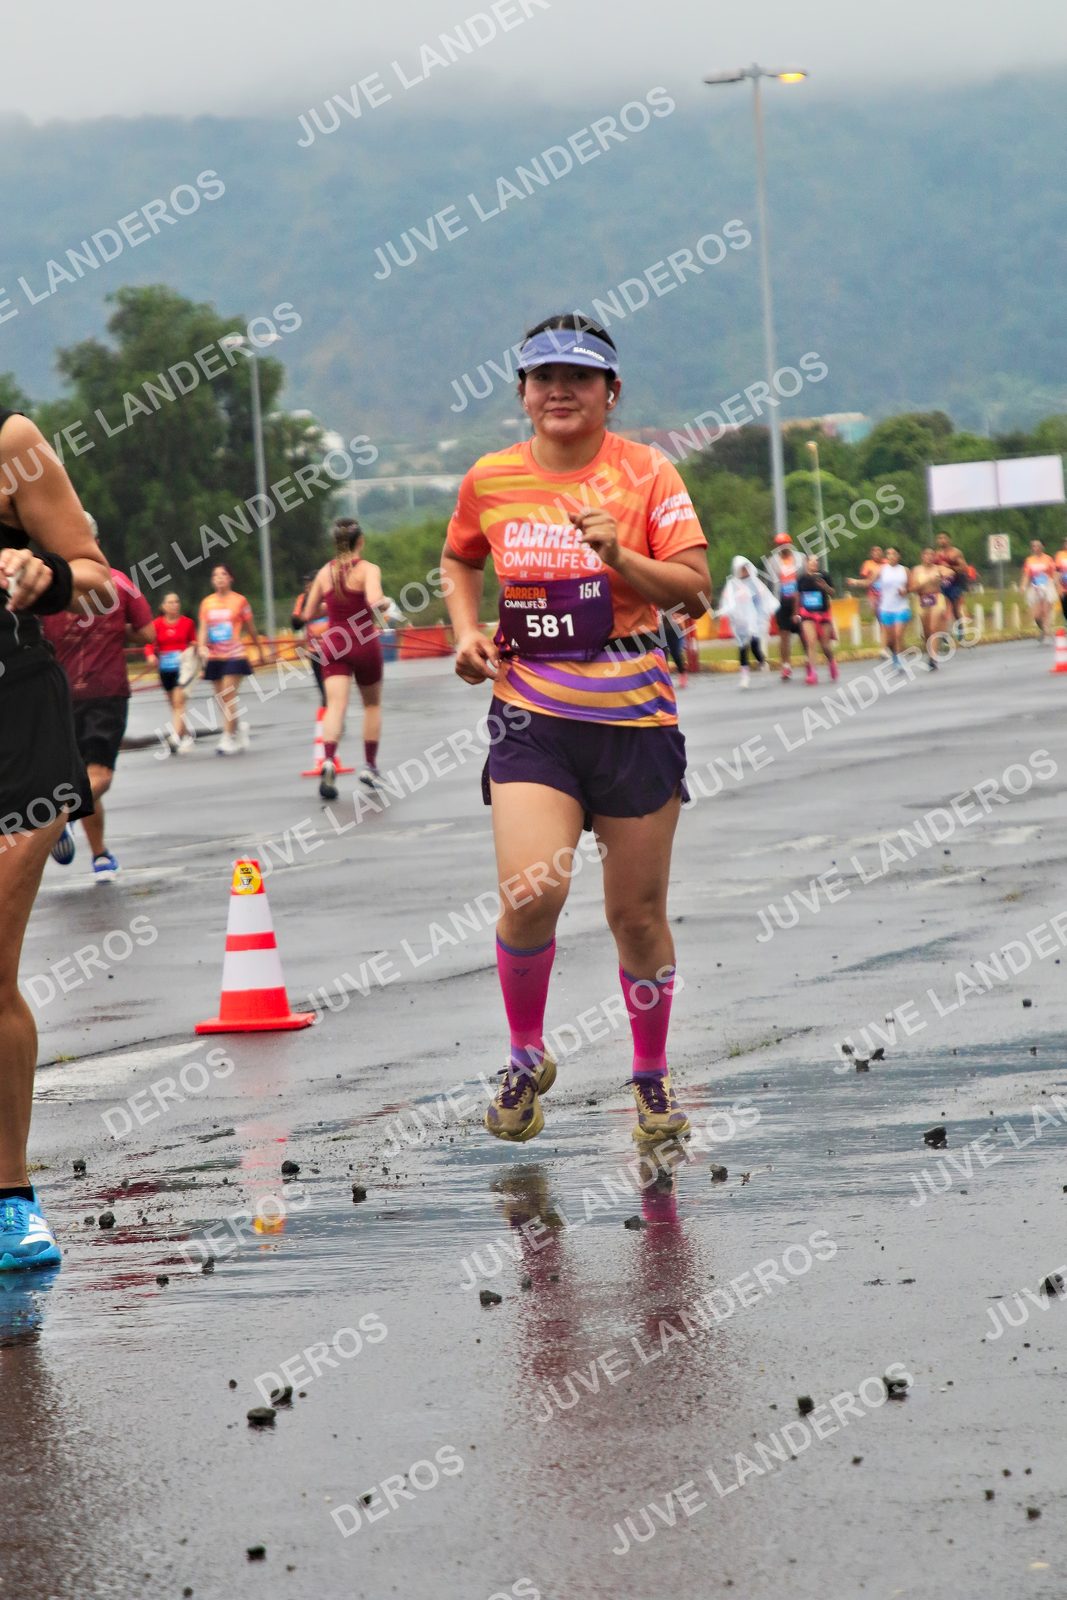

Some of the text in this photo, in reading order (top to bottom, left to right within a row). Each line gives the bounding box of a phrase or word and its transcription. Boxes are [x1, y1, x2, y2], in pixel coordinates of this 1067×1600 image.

[504, 522, 584, 549] CARRE
[503, 551, 579, 569] OMNILIFE
[504, 586, 547, 599] CARRERA
[579, 581, 601, 600] 15K
[526, 614, 575, 637] 581
